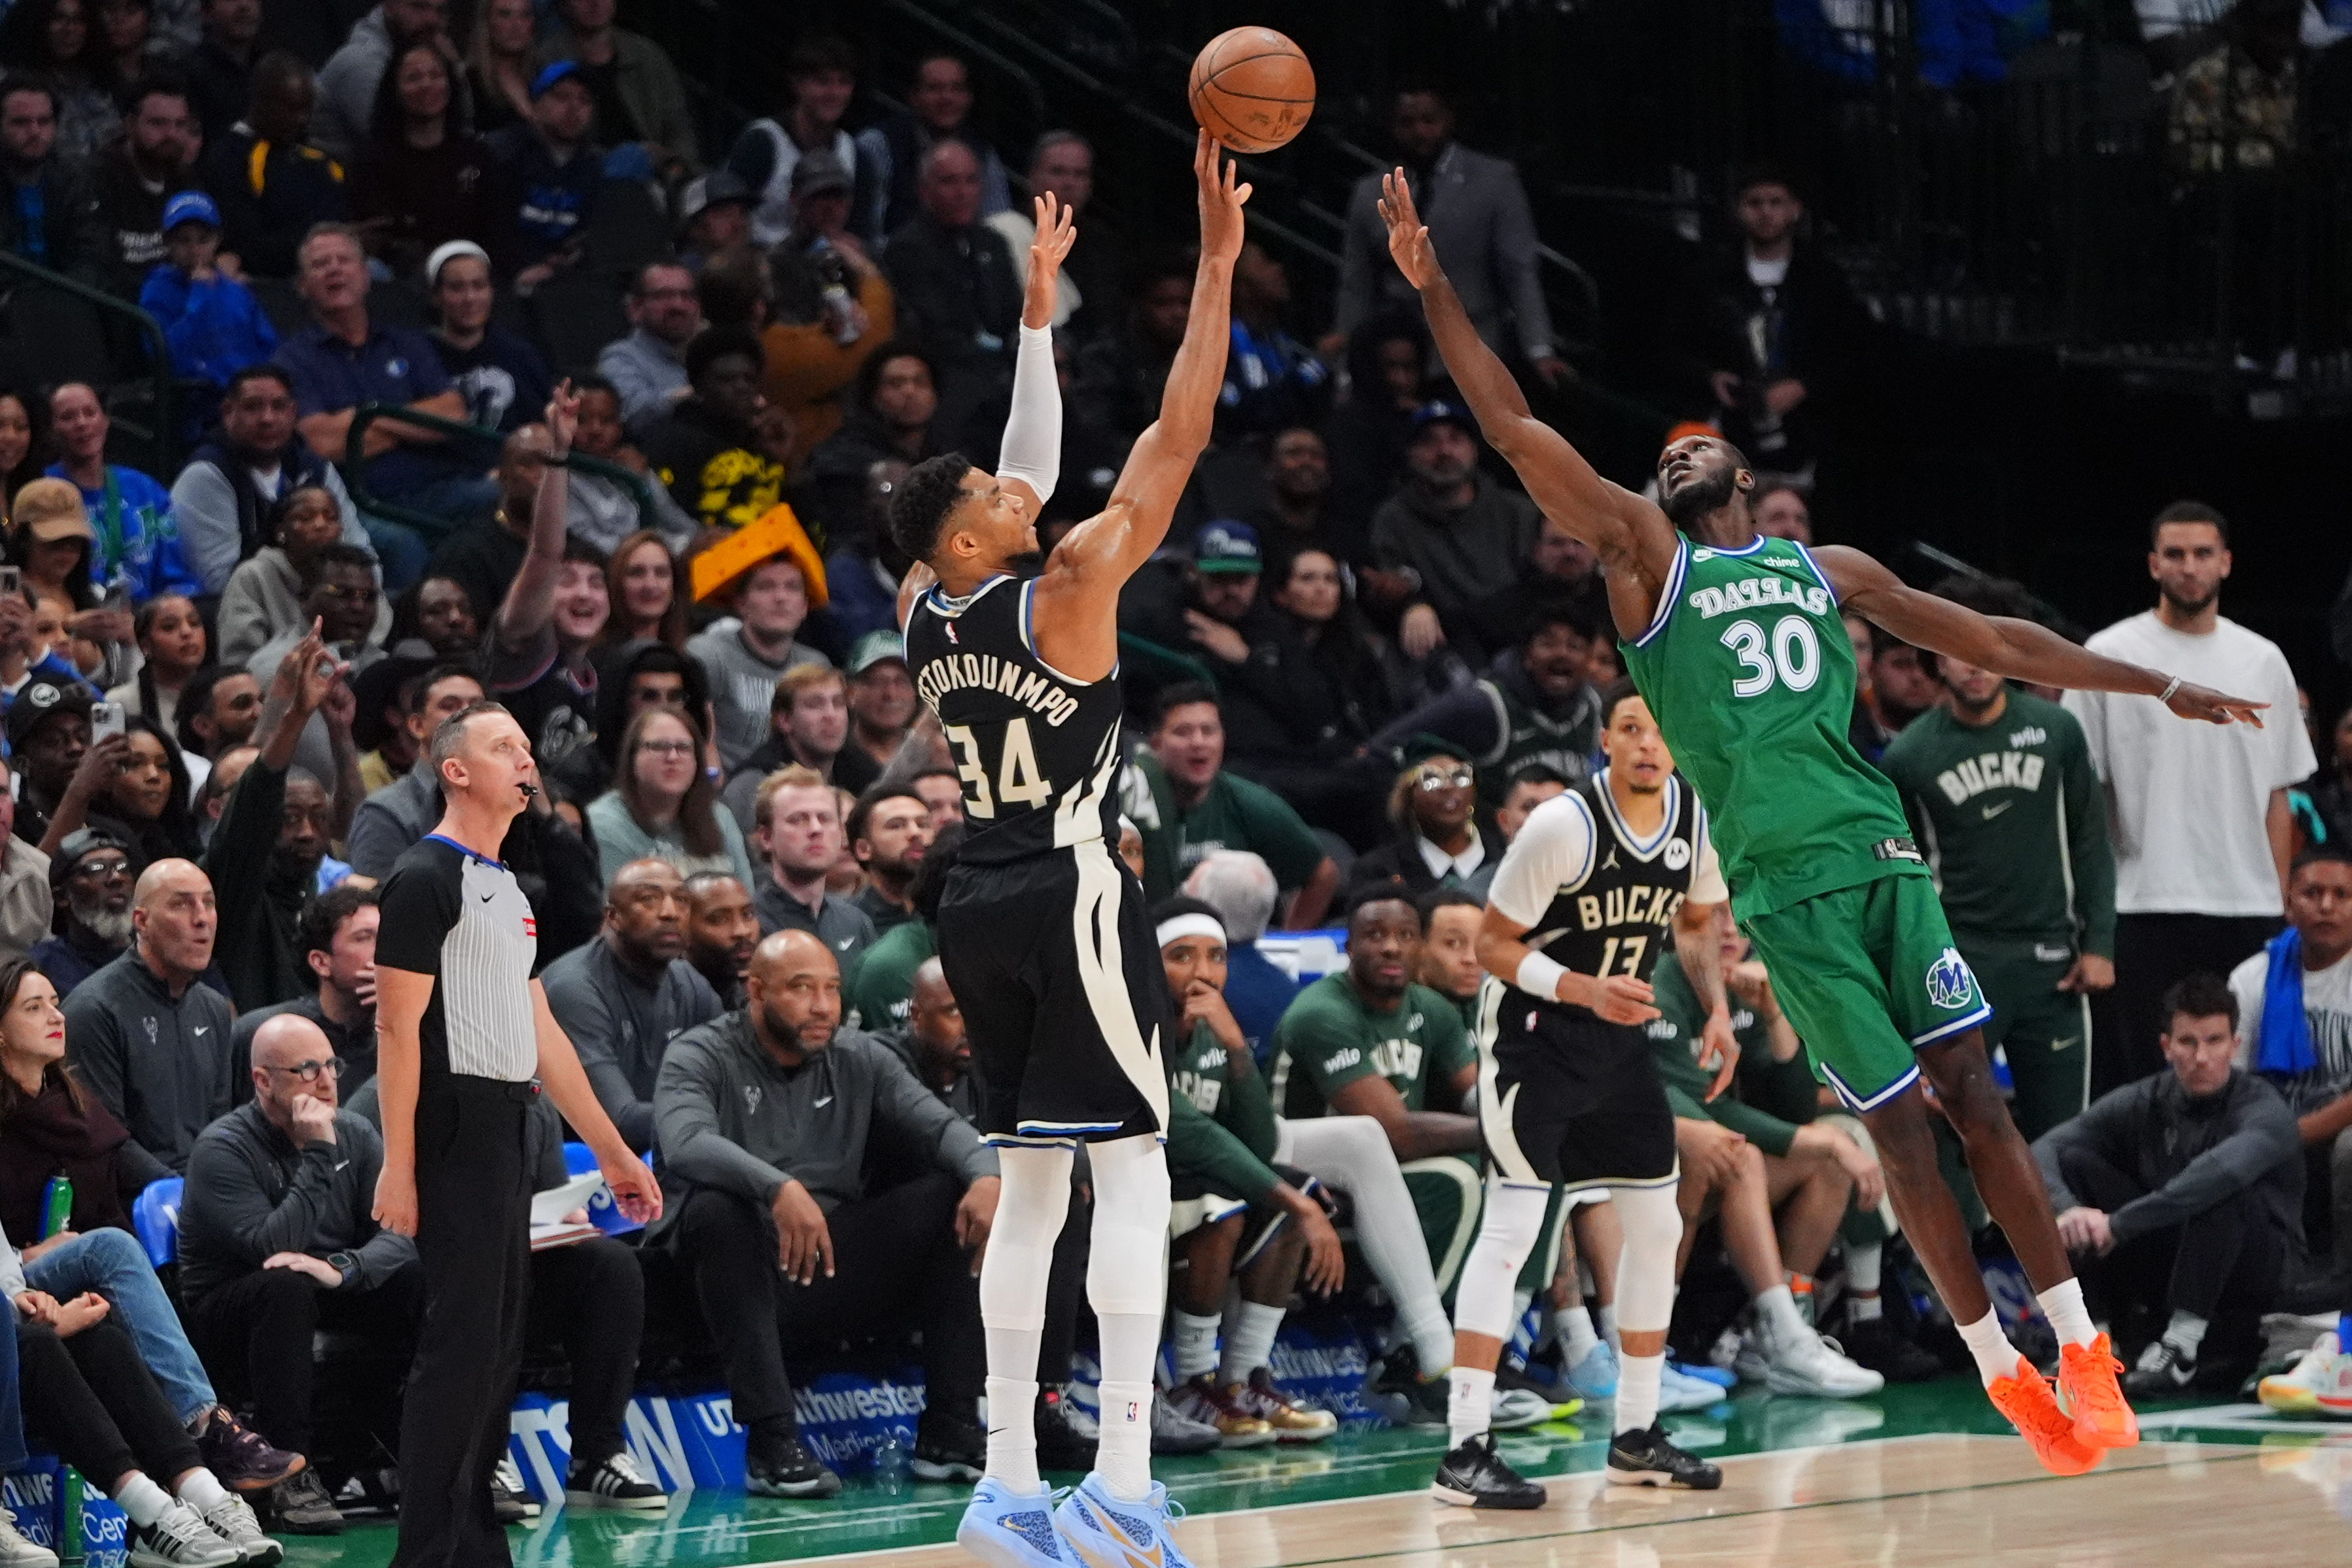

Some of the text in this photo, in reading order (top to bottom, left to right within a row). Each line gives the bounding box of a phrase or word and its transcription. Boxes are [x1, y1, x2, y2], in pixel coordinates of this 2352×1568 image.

[1764, 556, 1800, 567] chime
[1689, 578, 1828, 619] DALLAS
[1719, 615, 1821, 697] 30
[945, 716, 1053, 819] 34
[1937, 750, 2046, 807] BUCKS
[1577, 885, 1686, 931] BUCKS
[1597, 935, 1648, 980] 13
[83, 1512, 129, 1543] Cen
